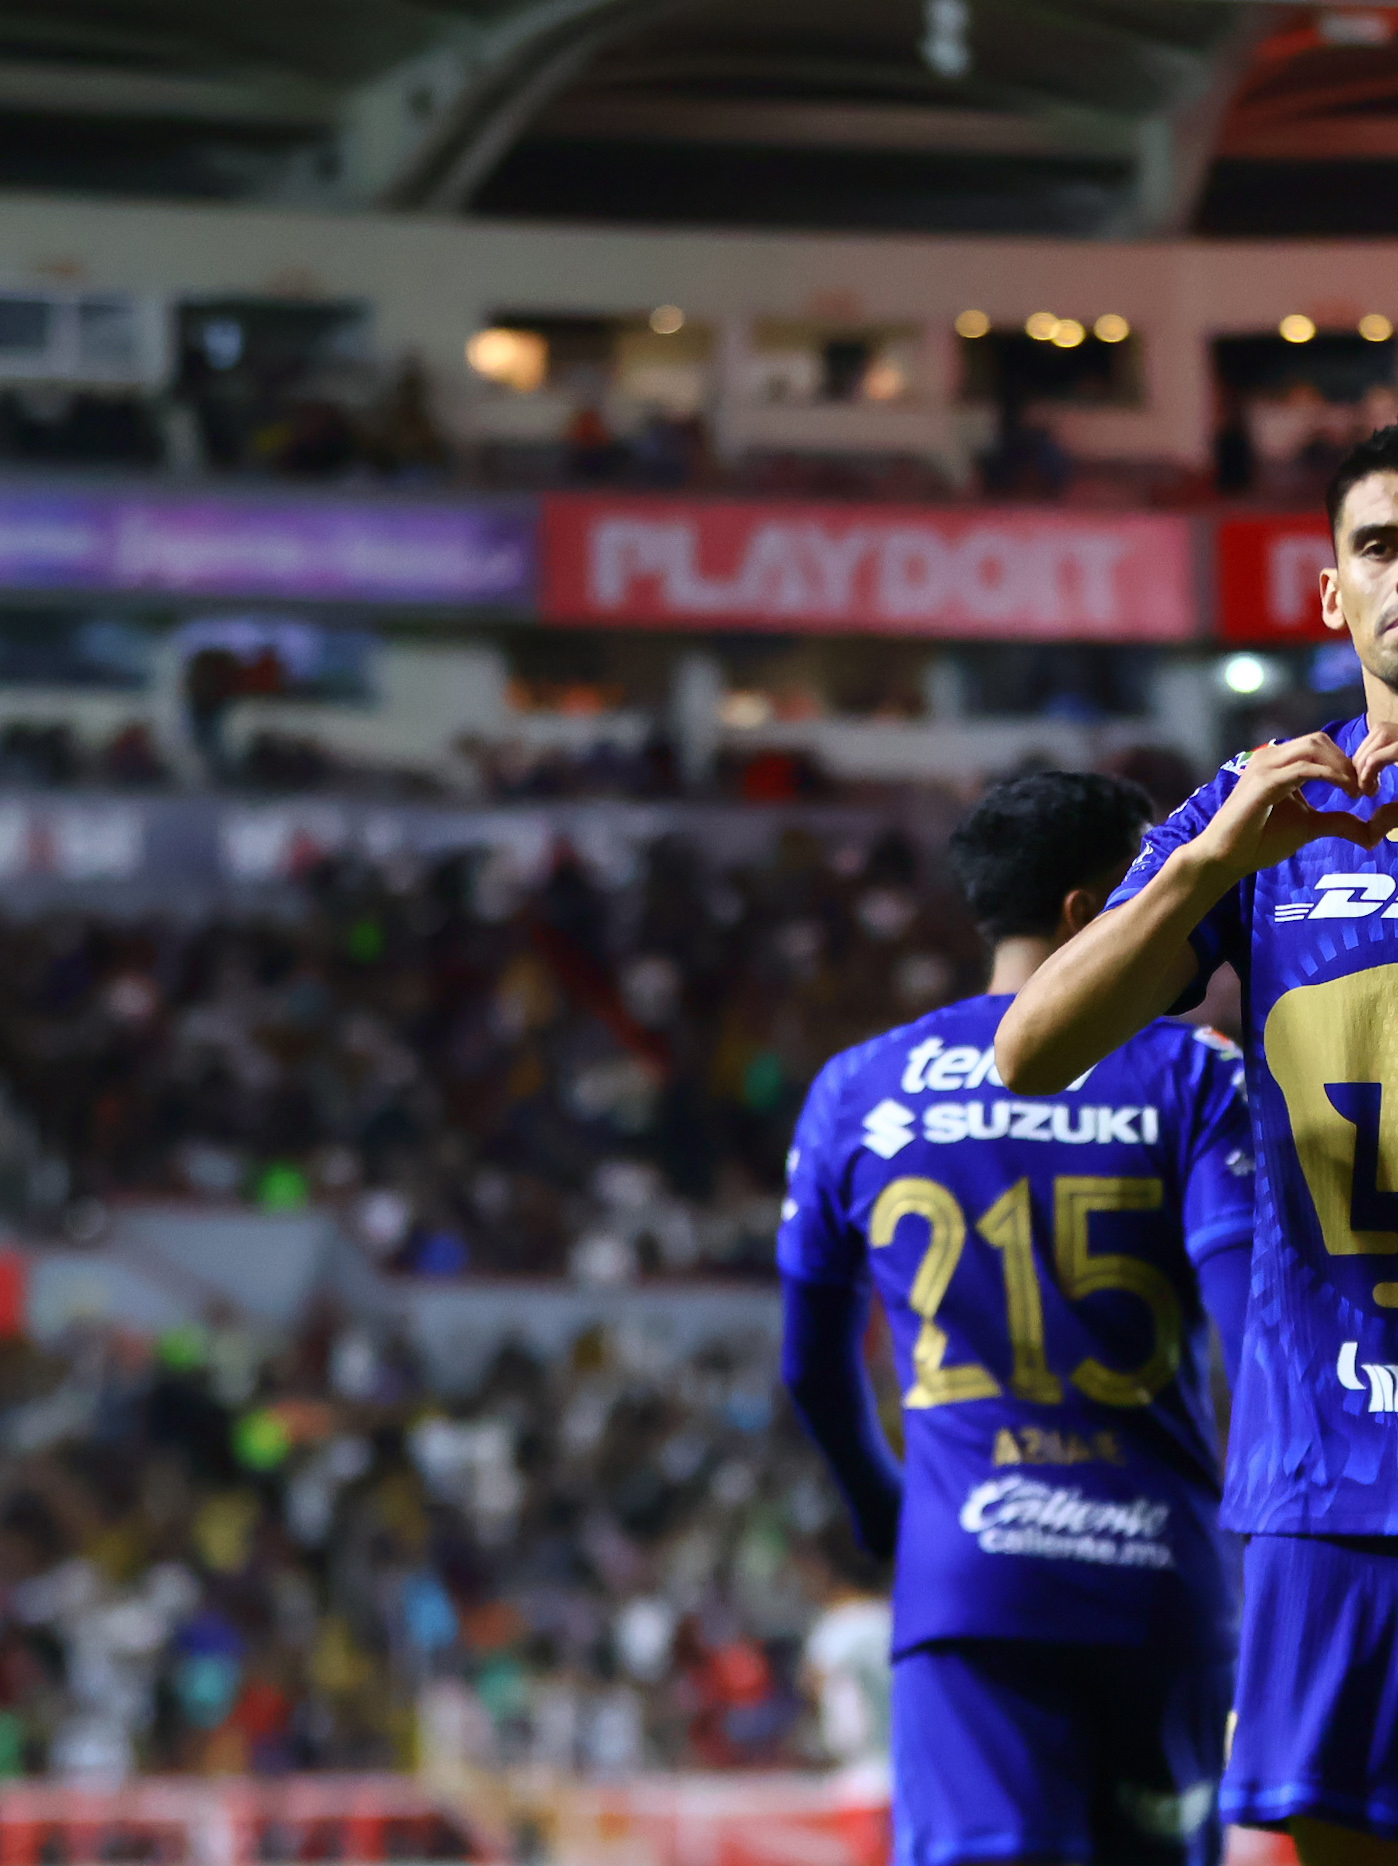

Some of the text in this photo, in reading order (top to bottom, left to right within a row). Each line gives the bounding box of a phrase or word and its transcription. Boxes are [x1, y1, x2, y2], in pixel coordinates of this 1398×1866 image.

[588, 518, 1120, 619] PLAYDOIT
[923, 1101, 1158, 1144] SUZUKI
[868, 1175, 1181, 1410] 215
